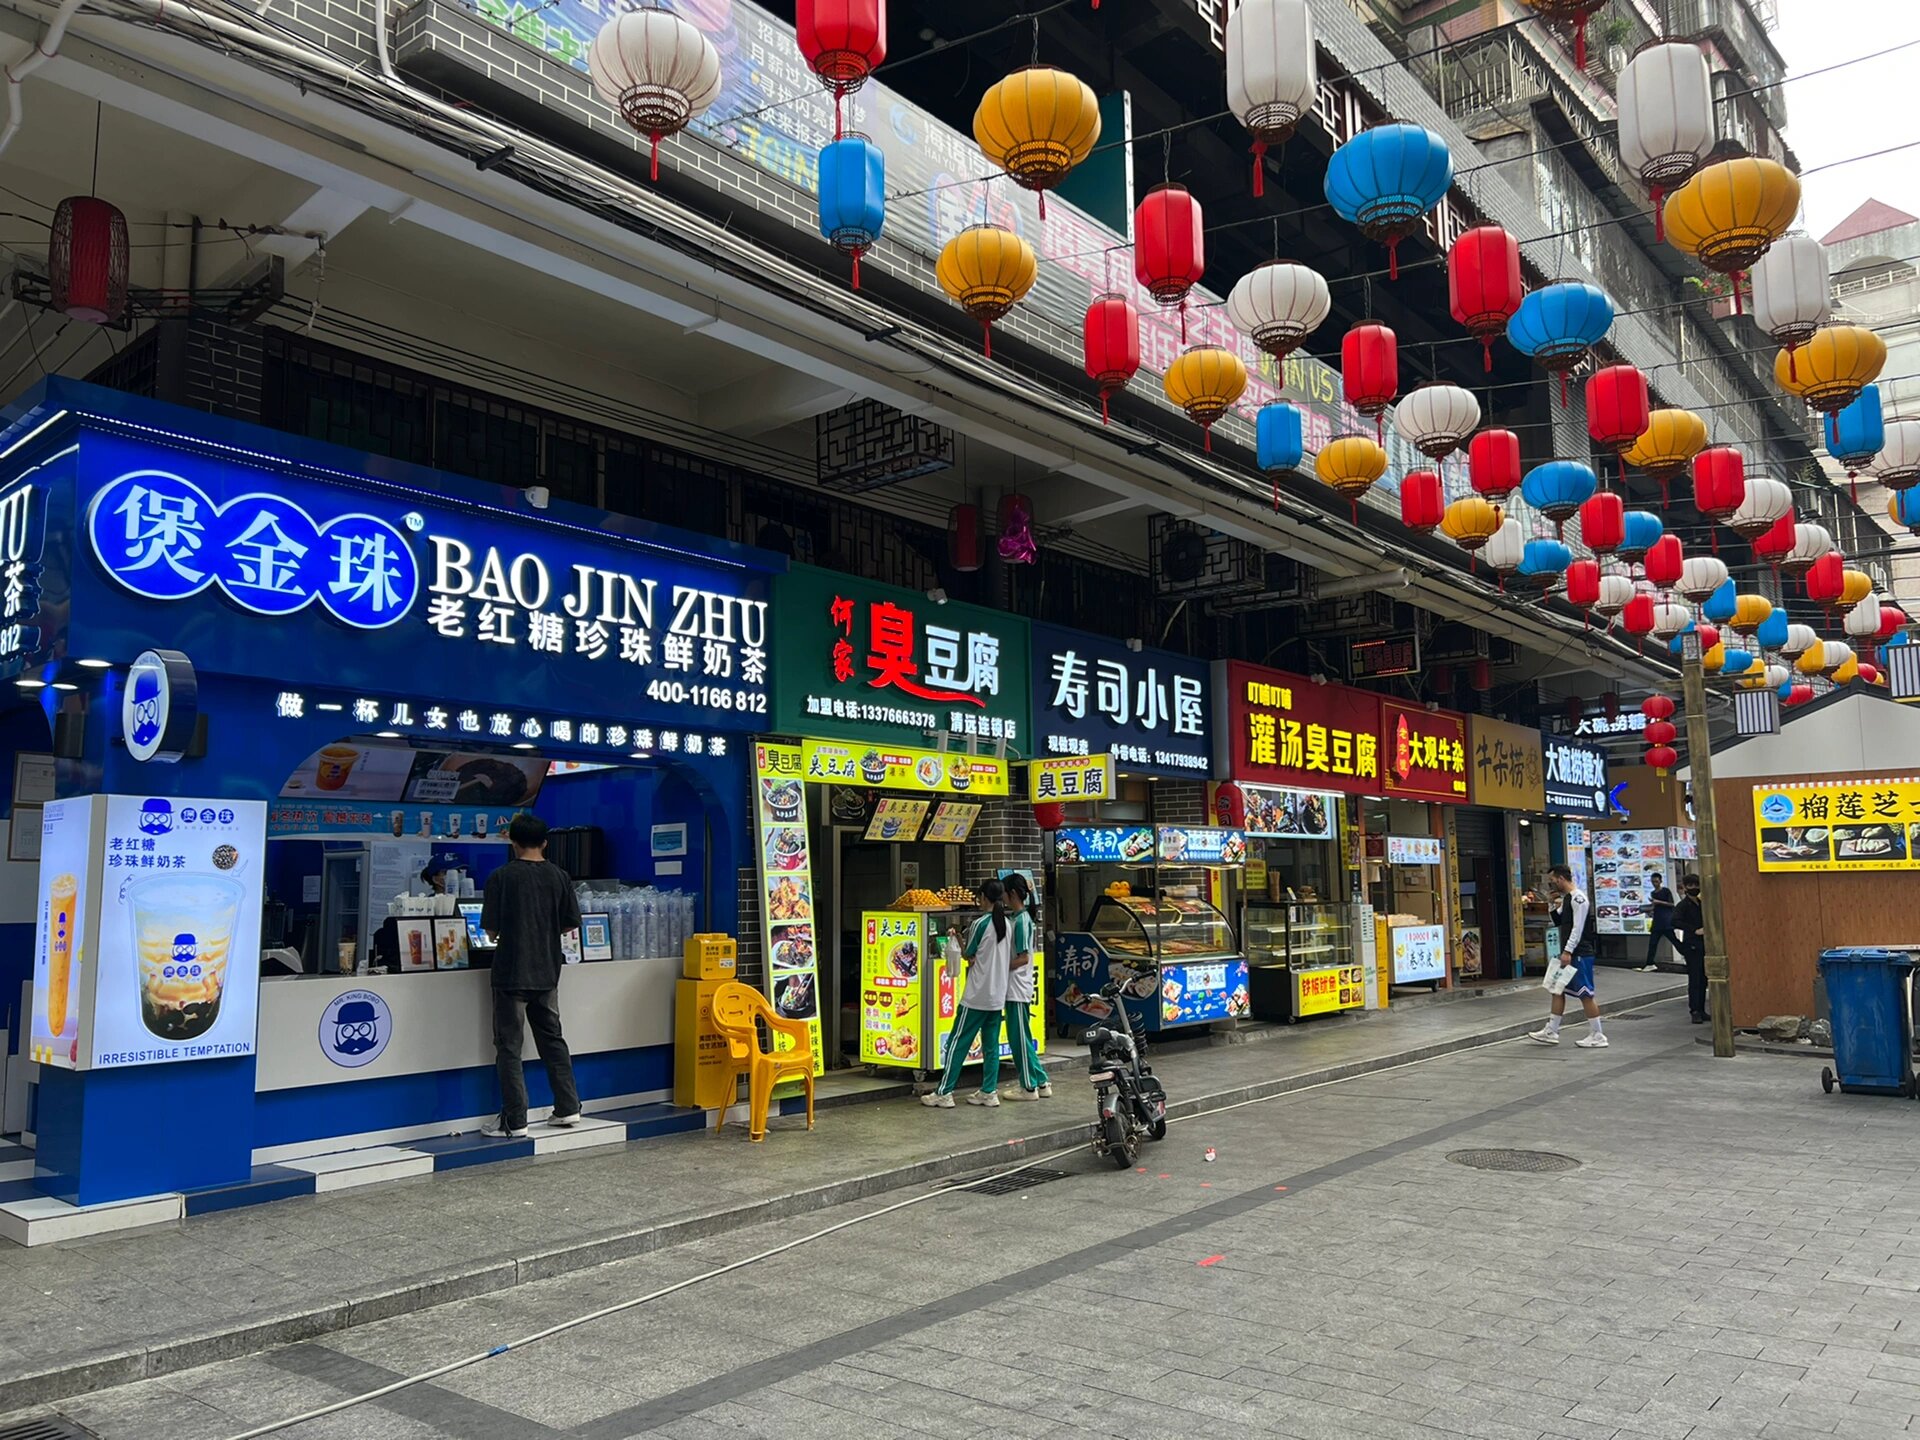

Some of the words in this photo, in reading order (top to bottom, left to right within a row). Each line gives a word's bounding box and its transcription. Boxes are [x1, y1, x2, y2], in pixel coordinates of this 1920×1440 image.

[1310, 360, 1334, 406] US
[113, 484, 402, 612] 煲金珠
[428, 535, 550, 610] BAO
[563, 564, 658, 629] JIN
[669, 585, 768, 649] ZHU
[427, 595, 767, 685] 老红糖珍珠鲜奶茶
[830, 595, 856, 683] 何家
[867, 602, 1000, 700] 臭豆腐
[647, 679, 733, 710] 400-1166
[735, 692, 767, 714] 812
[1051, 650, 1204, 736] 寿司小屋
[276, 691, 727, 757] 做一杯儿女也放心喝的珍珠鲜奶茶
[1574, 712, 1650, 736] 大碗捞糖
[768, 748, 802, 775] 臭豆腐
[1249, 712, 1377, 779] 灌汤臭豆腐
[1408, 731, 1465, 774] 大观牛杂
[809, 754, 857, 778] 臭豆腐
[1038, 768, 1103, 798] 臭豆腐
[1545, 742, 1607, 789] 大碗捞糖水
[109, 837, 156, 852] 老红糖
[1089, 829, 1119, 853] 寿司
[108, 853, 187, 869] 珍珠鲜奶茶
[880, 918, 917, 937] 臭豆腐
[1060, 944, 1099, 978] 寿司
[99, 1048, 179, 1064] IRRESISTIBLE
[184, 1042, 250, 1057] TEMPTATION
